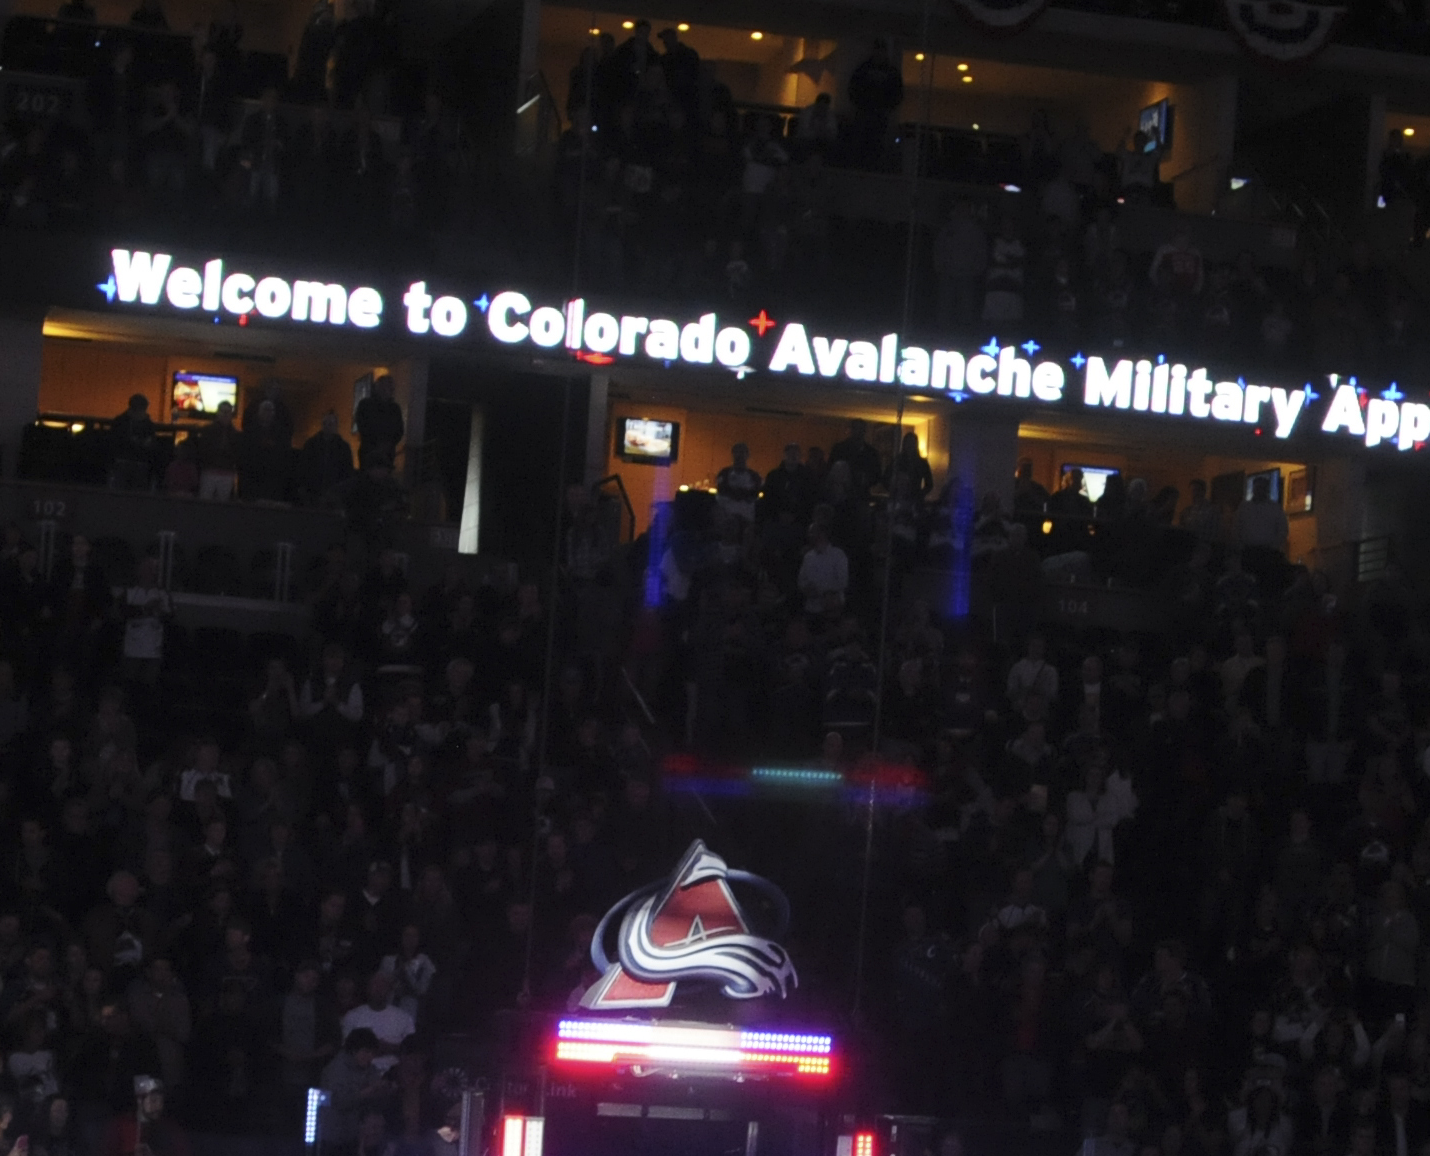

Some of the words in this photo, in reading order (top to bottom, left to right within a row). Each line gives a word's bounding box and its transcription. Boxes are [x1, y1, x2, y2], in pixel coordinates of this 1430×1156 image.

[16, 91, 60, 114] 202
[111, 248, 384, 329] Welcome
[403, 280, 468, 337] to
[487, 289, 751, 367] Colorado
[768, 322, 1064, 402] Avalanche
[1083, 355, 1307, 440] Military
[33, 499, 66, 517] 102
[1058, 598, 1089, 615] 104
